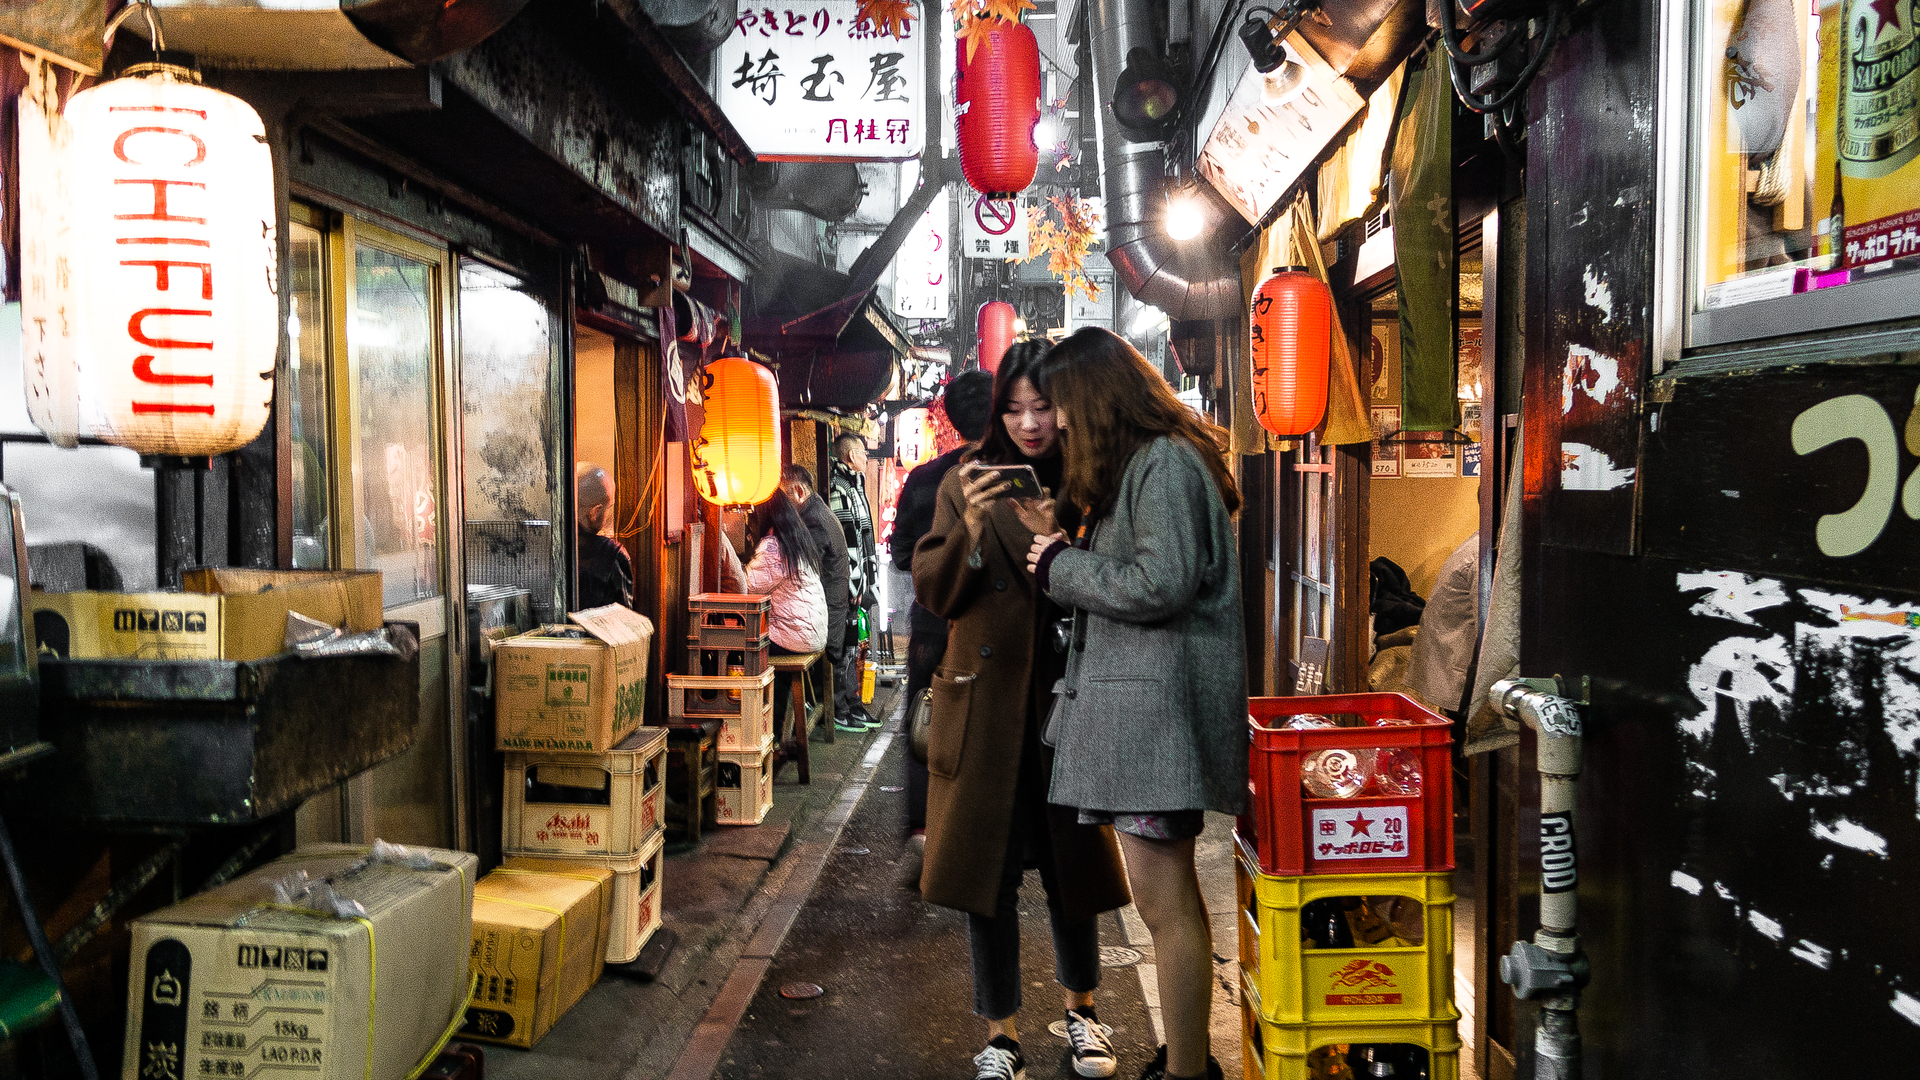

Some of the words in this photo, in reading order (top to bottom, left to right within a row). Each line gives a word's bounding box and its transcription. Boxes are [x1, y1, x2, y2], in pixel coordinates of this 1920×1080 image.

[732, 48, 909, 106] 埼玉屋
[826, 118, 910, 144] 月桂冠
[975, 239, 1020, 253] 禁煙
[109, 106, 215, 417] ICHIFUJI
[546, 812, 590, 830] Asahi
[1384, 818, 1402, 833] 20
[1318, 841, 1404, 855] サッポロビール
[273, 1020, 308, 1039] 15kg
